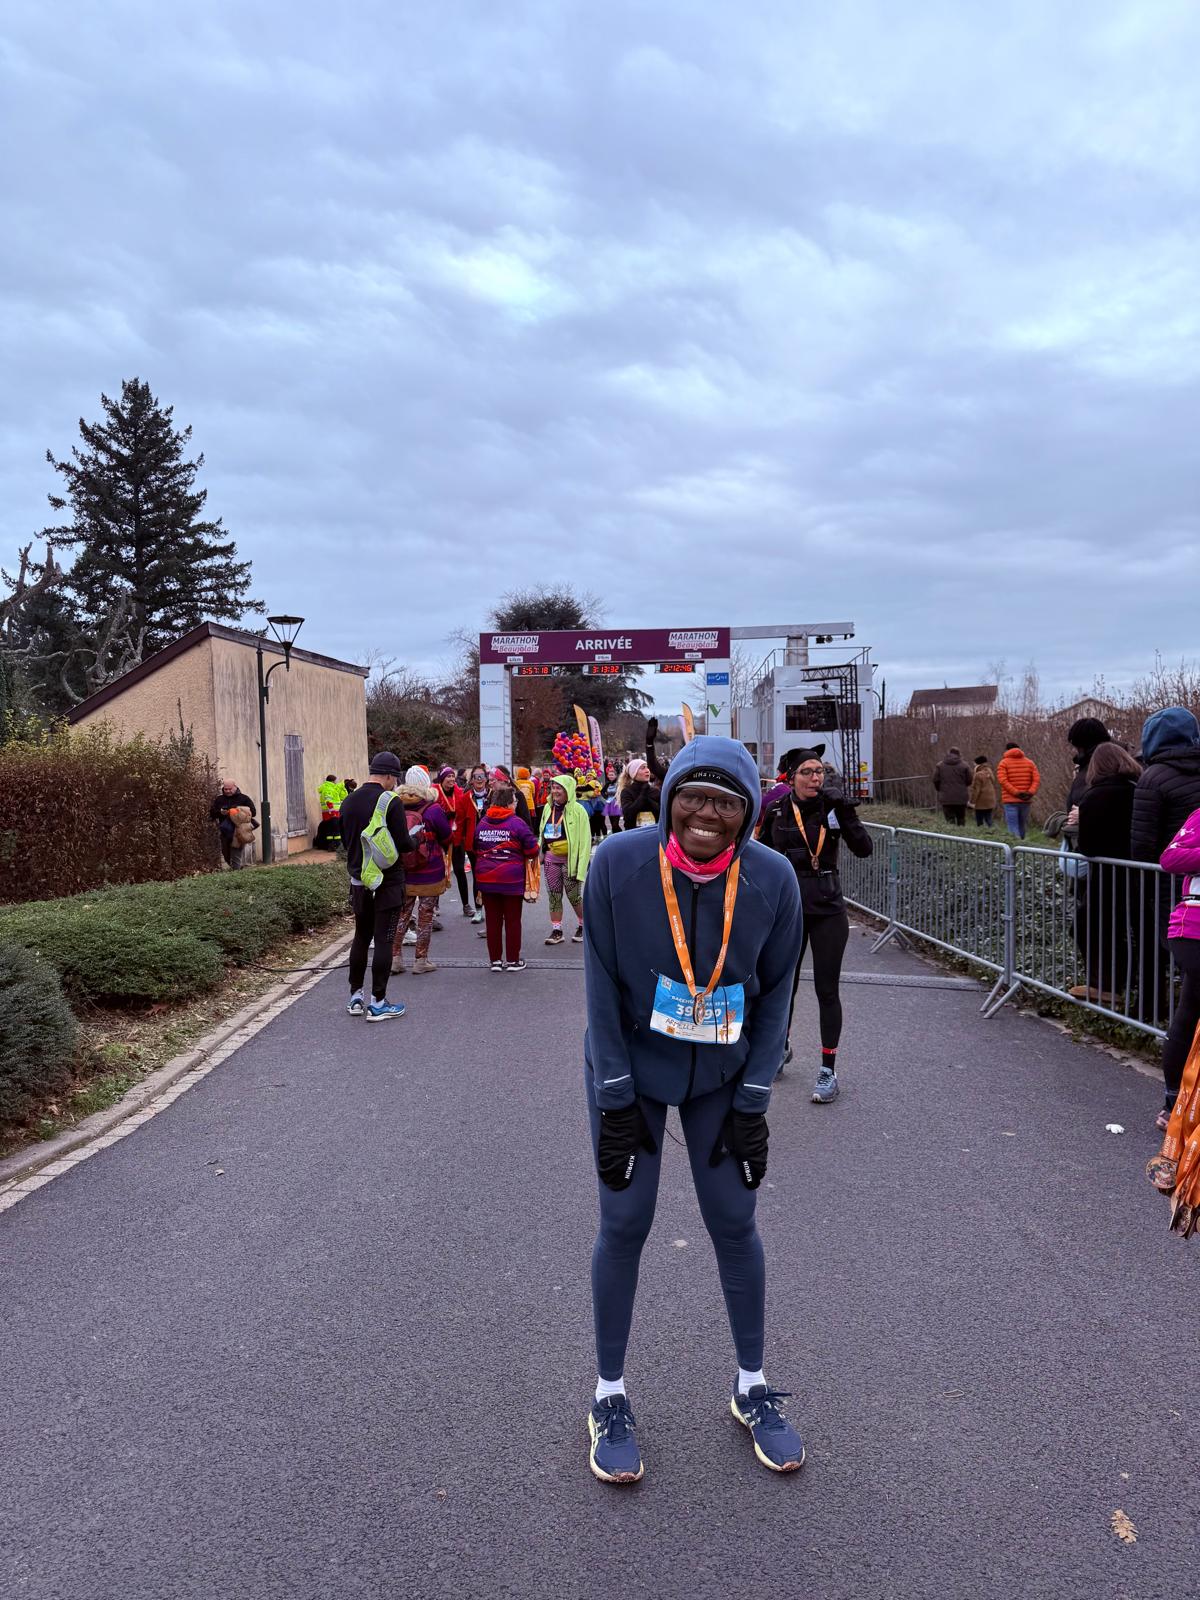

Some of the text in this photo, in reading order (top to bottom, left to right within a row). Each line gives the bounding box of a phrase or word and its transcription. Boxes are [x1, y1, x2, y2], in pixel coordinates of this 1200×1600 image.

[492, 636, 538, 645] MARATHON
[575, 636, 633, 650] ARRIVÉE
[669, 632, 717, 641] MARATHON
[676, 1003, 722, 1020] 3990
[624, 1155, 635, 1180] KIPRUN
[742, 1160, 752, 1182] KIPRUN
